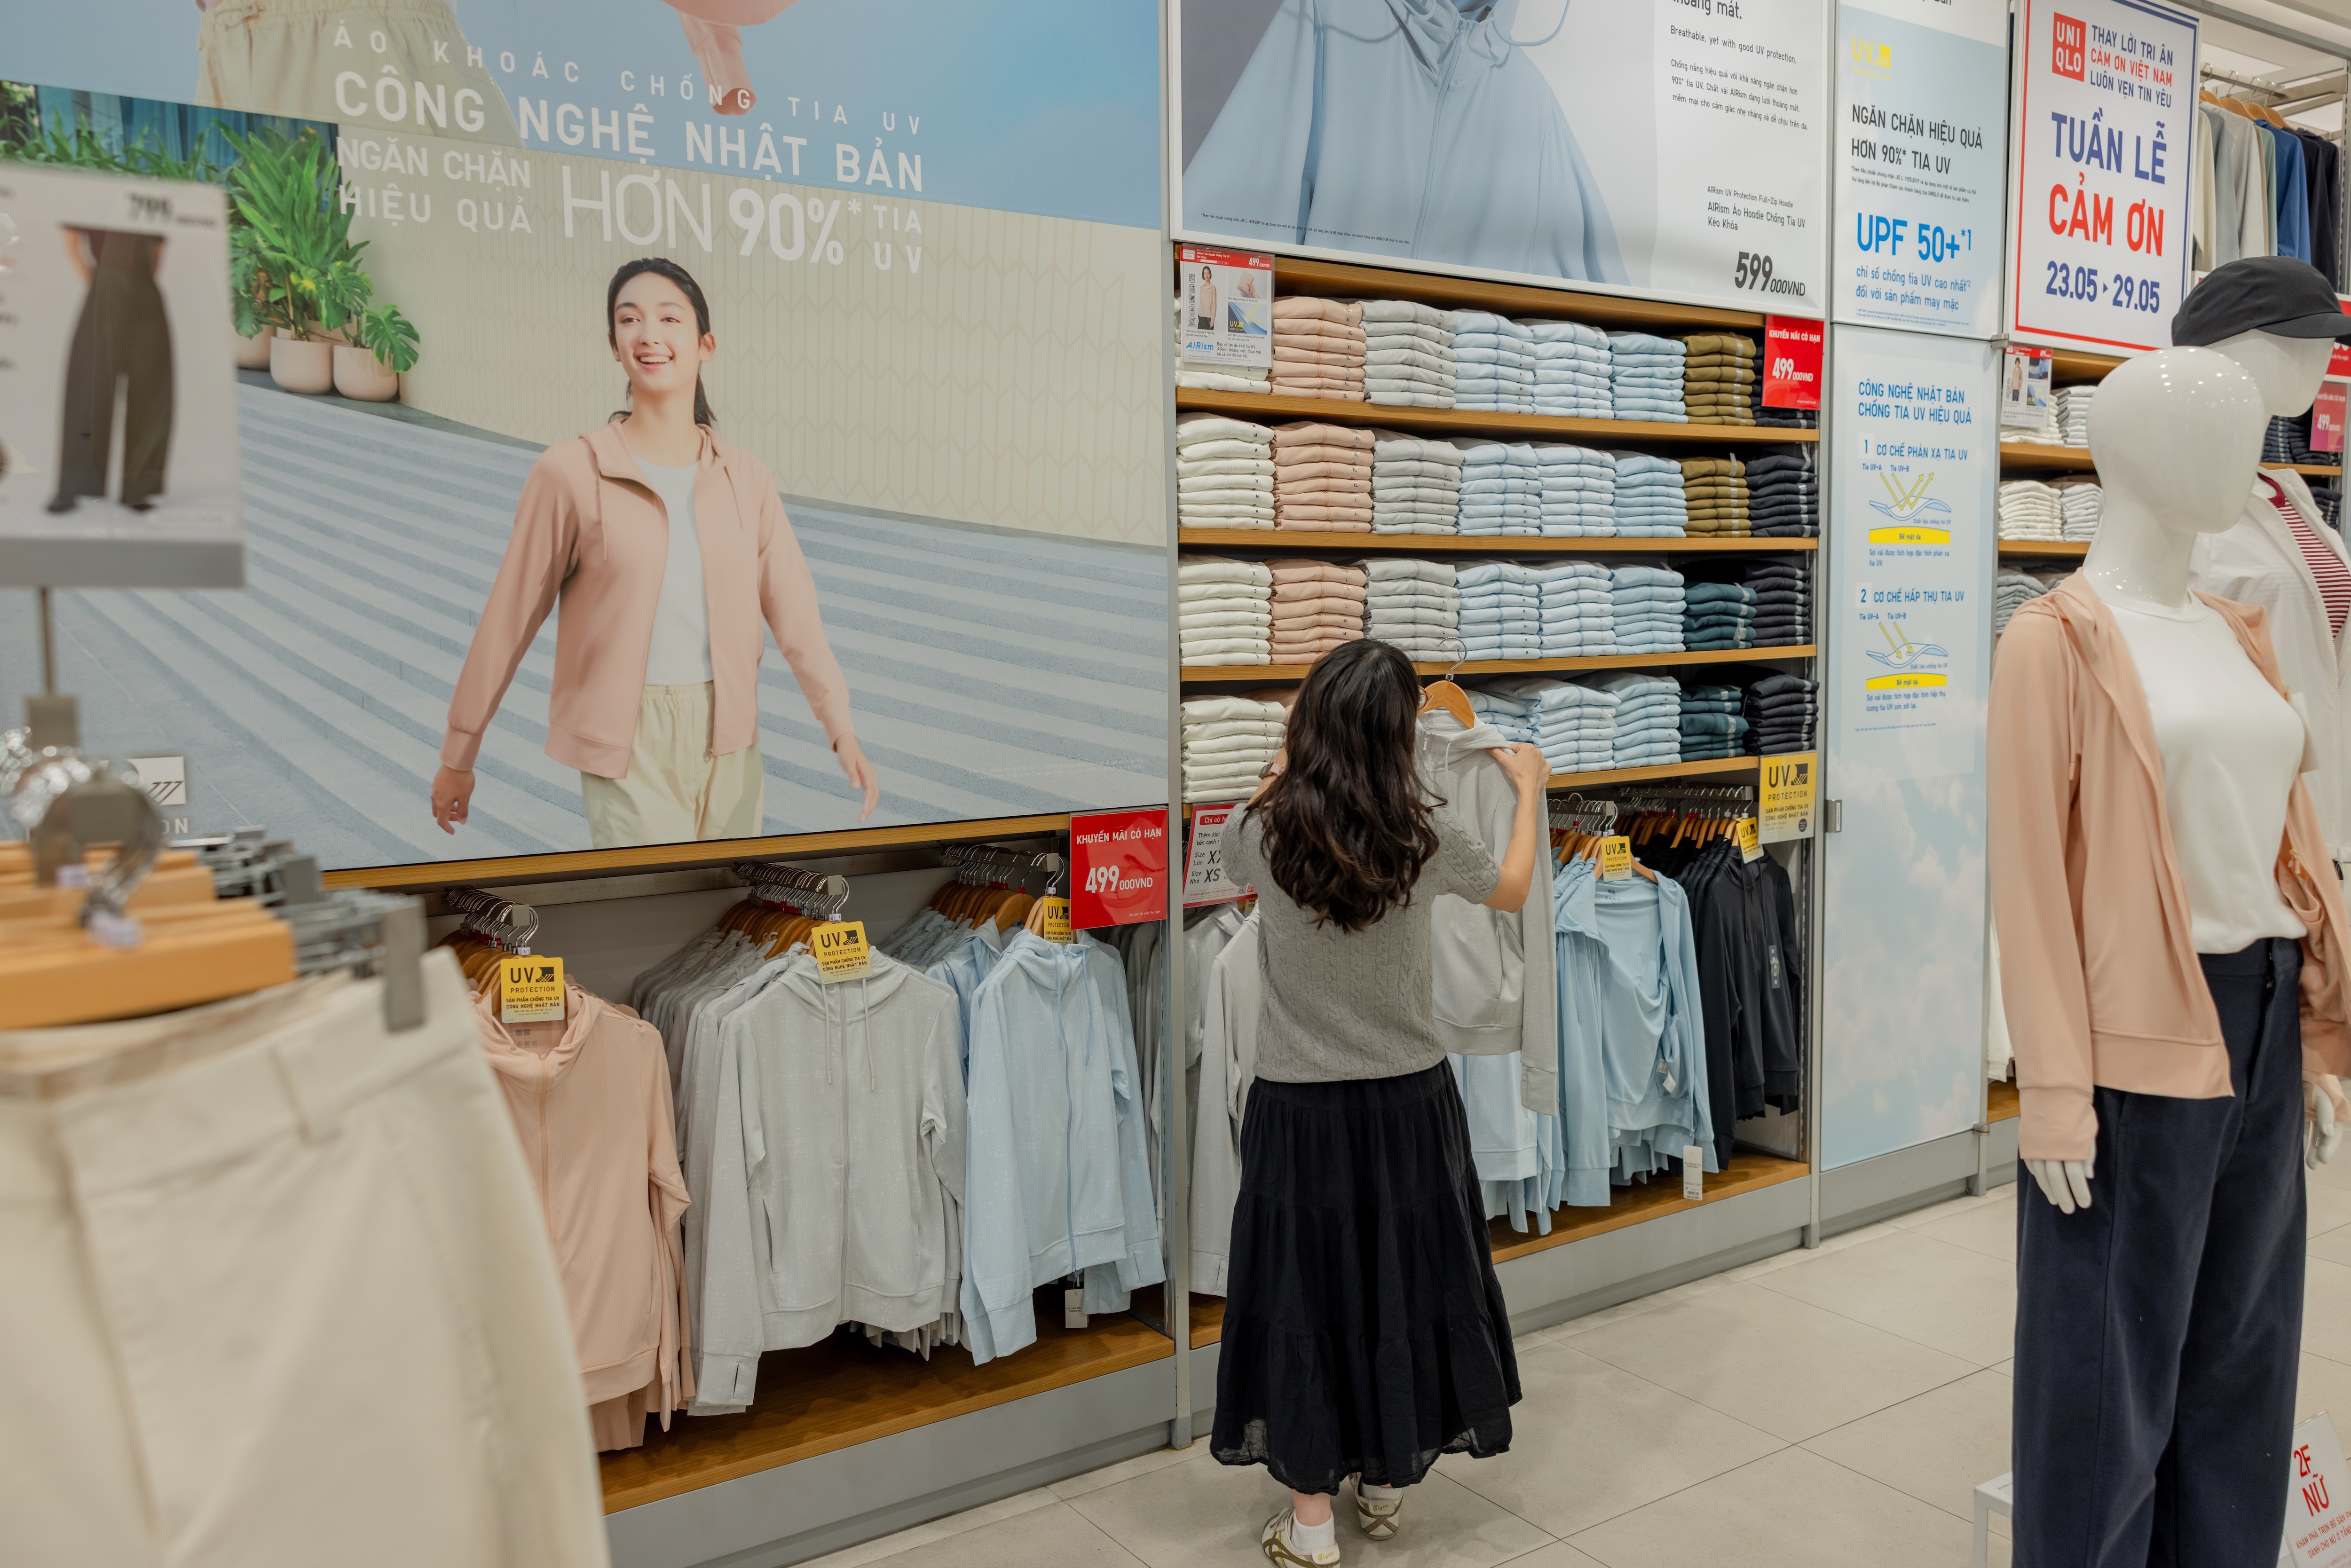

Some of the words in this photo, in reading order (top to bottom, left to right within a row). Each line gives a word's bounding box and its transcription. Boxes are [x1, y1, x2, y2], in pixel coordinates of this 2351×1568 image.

[1717, 0, 1742, 19] mát.
[1671, 25, 1706, 43] Breathable,
[1710, 36, 1719, 45] yet
[1722, 38, 1736, 48] with
[1739, 43, 1753, 52] good
[1757, 46, 1764, 55] UV
[1767, 49, 1797, 64] protection.
[2057, 21, 2080, 48] UNI
[2092, 25, 2117, 47] THAY
[2122, 33, 2136, 55] LỜI
[2141, 42, 2155, 61] TRI
[2160, 44, 2173, 66] ÂN
[1853, 38, 1873, 64] UV
[2056, 47, 2081, 72] QLO
[334, 19, 387, 53] ÁO
[434, 40, 579, 83] KHOÁC
[621, 70, 750, 109] CHỐNG
[788, 97, 847, 124] TIA
[884, 111, 920, 135] UV
[1672, 59, 1688, 71] Chống
[1690, 63, 1703, 74] nắng
[1705, 66, 1716, 76] hiệu
[1740, 73, 1748, 83] khả
[1751, 78, 1761, 87] năng
[1777, 83, 1787, 93] chặn
[1852, 66, 1891, 82] PROTECTION
[2091, 45, 2110, 68] CẢM
[2114, 55, 2125, 73] ƠN
[2130, 60, 2149, 81] VIỆT
[2154, 68, 2172, 87] NAM
[2091, 71, 2113, 91] LUÔN
[2118, 79, 2134, 99] VẸN
[2138, 85, 2151, 102] TIN
[2156, 89, 2171, 108] YÊU
[336, 65, 485, 132] CÔNG
[520, 103, 656, 164] NGHỆ
[686, 121, 807, 181] NHẬT
[836, 137, 922, 192] BẢN
[1853, 104, 1886, 128] NGĂN
[1892, 113, 1924, 139] CHẶN
[1930, 120, 1955, 145] HIỆU
[1960, 127, 1982, 149] QUẢ
[1852, 138, 1876, 160] HƠN
[1912, 150, 1930, 170] TIA
[1936, 156, 1950, 174] UV
[2051, 107, 2123, 173] TUẦN
[2135, 121, 2166, 184] LỄ
[337, 136, 428, 175] NGĂN
[444, 150, 530, 191] CHẶN
[339, 184, 431, 227] HIỆU
[458, 196, 532, 233] QUẢ
[562, 166, 713, 252] HƠN
[1707, 186, 1723, 195] AIRism
[1734, 190, 1757, 201] Protection
[1759, 195, 1777, 206] Full-Zip
[1779, 198, 1793, 208] Hoodie
[873, 205, 922, 234] TIA
[1708, 202, 1729, 214] AIRism
[1733, 204, 1741, 216] Áo
[1744, 207, 1764, 220] Hoodie
[1767, 213, 1784, 226] Chống
[1798, 219, 1805, 228] UV
[1708, 216, 1720, 227] Kéo
[1723, 219, 1738, 230] Khóa
[2049, 172, 2113, 245] CẢM
[2127, 198, 2164, 257] ƠN
[1858, 213, 1907, 255] UPF
[874, 243, 922, 273] UV
[1856, 265, 1868, 277] chỉ
[1871, 267, 1879, 279] số
[1883, 269, 1905, 286] chống
[1909, 273, 1917, 285] tia
[1921, 274, 1932, 287] UV
[1935, 279, 1947, 289] cao
[2046, 261, 2098, 302] 23.05
[2113, 274, 2160, 313] 29.05
[1856, 284, 1867, 299] đối
[1871, 287, 1881, 300] với
[1885, 290, 1897, 302] sản
[1901, 290, 1921, 306] phẩm
[1925, 298, 1940, 310] may
[1944, 299, 1958, 312] mặc
[1186, 342, 1214, 350] AIRism
[1769, 328, 1789, 339] KHUYẾN
[1791, 331, 1800, 340] MÃI
[1801, 332, 1808, 341] CÓ
[1809, 334, 1820, 344] HẠN
[1859, 378, 1884, 397] CÔNG
[1888, 382, 1913, 402] NGHỆ
[1917, 385, 1942, 403] NHẬT
[1946, 386, 1964, 404] BẢN
[1859, 398, 1890, 418] CHỐNG
[1895, 405, 1909, 419] TIA
[1914, 407, 1925, 420] UV
[1929, 406, 1949, 425] HIỆU
[1954, 407, 1971, 425] QUẢ
[1865, 440, 1868, 454] 1
[1877, 444, 1886, 455] CƠ
[1890, 442, 1905, 457] CHẾ
[1908, 444, 1928, 457] PHẢN
[1931, 448, 1941, 461] XẠ
[1944, 449, 1955, 459] TIA
[1959, 449, 1968, 460] UV
[1861, 589, 1866, 603] 2
[1874, 591, 1884, 602] CƠ
[1887, 587, 1901, 602] CHẾ
[1905, 588, 1920, 602] HẤP
[1924, 591, 1937, 604] THỤ
[1941, 591, 1952, 601] TIA
[1955, 591, 1964, 601] UV
[1769, 765, 1790, 788] UV
[1768, 790, 1807, 801] PROTECTION
[1077, 830, 1109, 844] KHUYẾN
[1113, 829, 1128, 840] MÃI
[1131, 828, 1141, 839] CÓ
[1144, 828, 1161, 840] HẠN
[1204, 868, 1221, 882] XS
[510, 967, 534, 983] UV
[2293, 1444, 2311, 1477] 2F
[2302, 1473, 2329, 1517] NỮ
